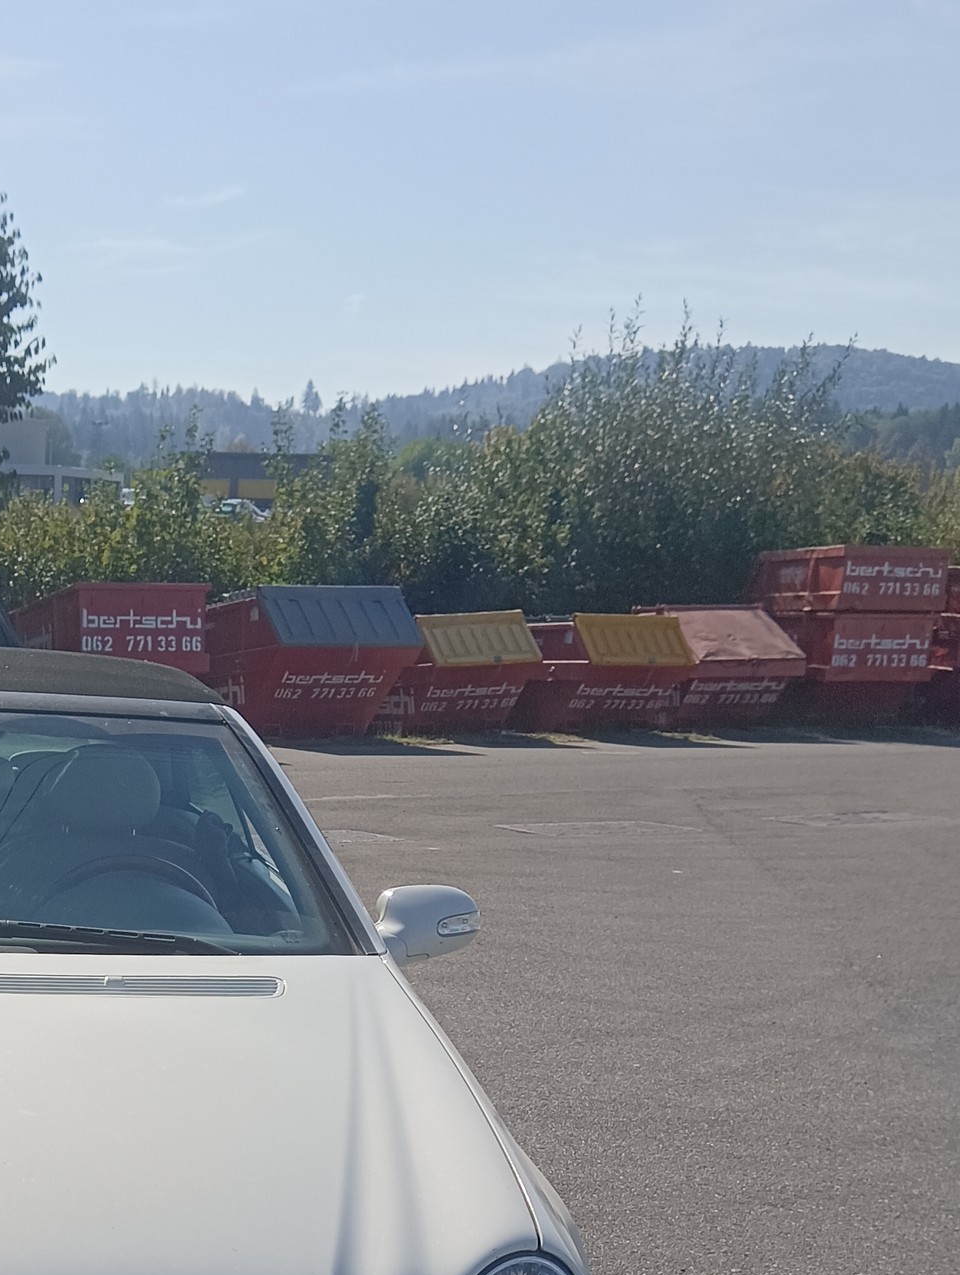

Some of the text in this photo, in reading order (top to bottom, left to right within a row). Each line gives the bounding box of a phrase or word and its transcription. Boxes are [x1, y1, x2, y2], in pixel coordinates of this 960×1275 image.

[846, 560, 942, 578] bertschi
[843, 582, 940, 596] 062 771 33 66
[82, 607, 202, 629] bertschi
[82, 635, 201, 652] 062 771 33 66
[834, 633, 930, 650] bertschi
[832, 654, 927, 668] 062 771 33 66
[281, 670, 387, 685] bertschi
[273, 687, 377, 700] 062 771 33 66
[420, 696, 518, 712] 062 771 33 66
[568, 698, 595, 709] 062
[603, 699, 626, 710] 771
[627, 699, 645, 710] 33
